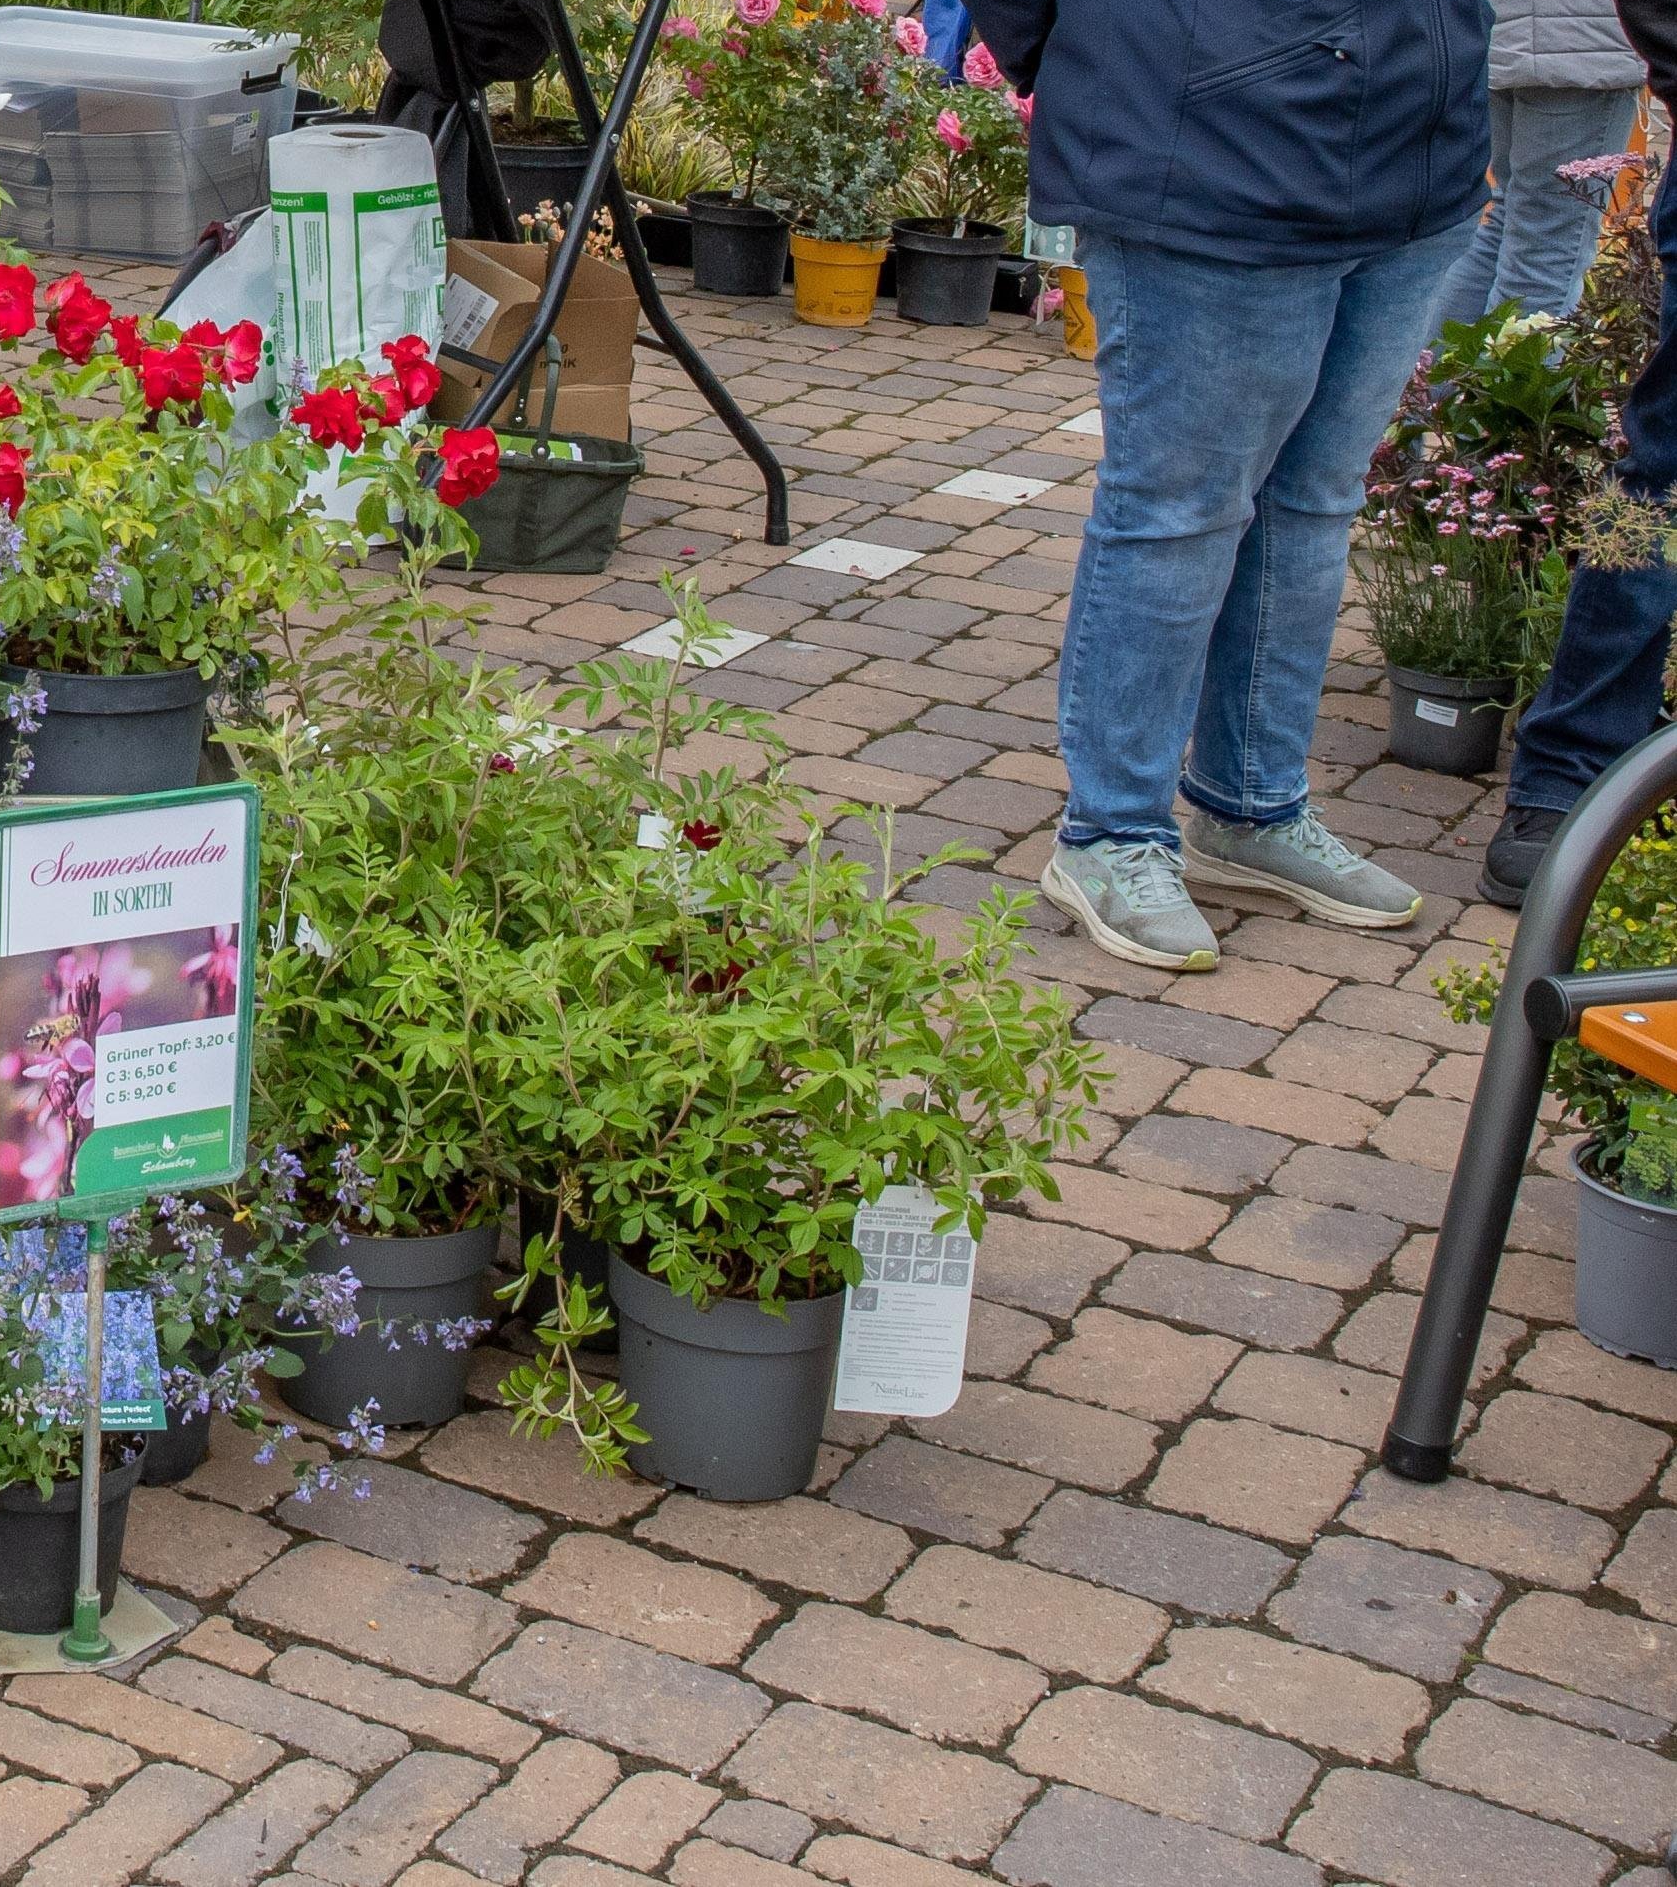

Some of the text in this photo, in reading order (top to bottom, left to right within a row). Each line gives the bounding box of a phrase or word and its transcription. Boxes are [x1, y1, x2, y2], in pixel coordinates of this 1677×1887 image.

[271, 197, 304, 207] anzen!
[277, 292, 286, 335] Pflanzen
[30, 828, 230, 887] Sommerstauden
[93, 881, 173, 917] IN SORTEN
[107, 1031, 236, 1063] Grüner Topf: 3,20 €
[106, 1061, 177, 1084] C 3: 6,50 €
[105, 1082, 177, 1104] C 5: 9,20 €
[140, 1156, 197, 1174] Schomberg
